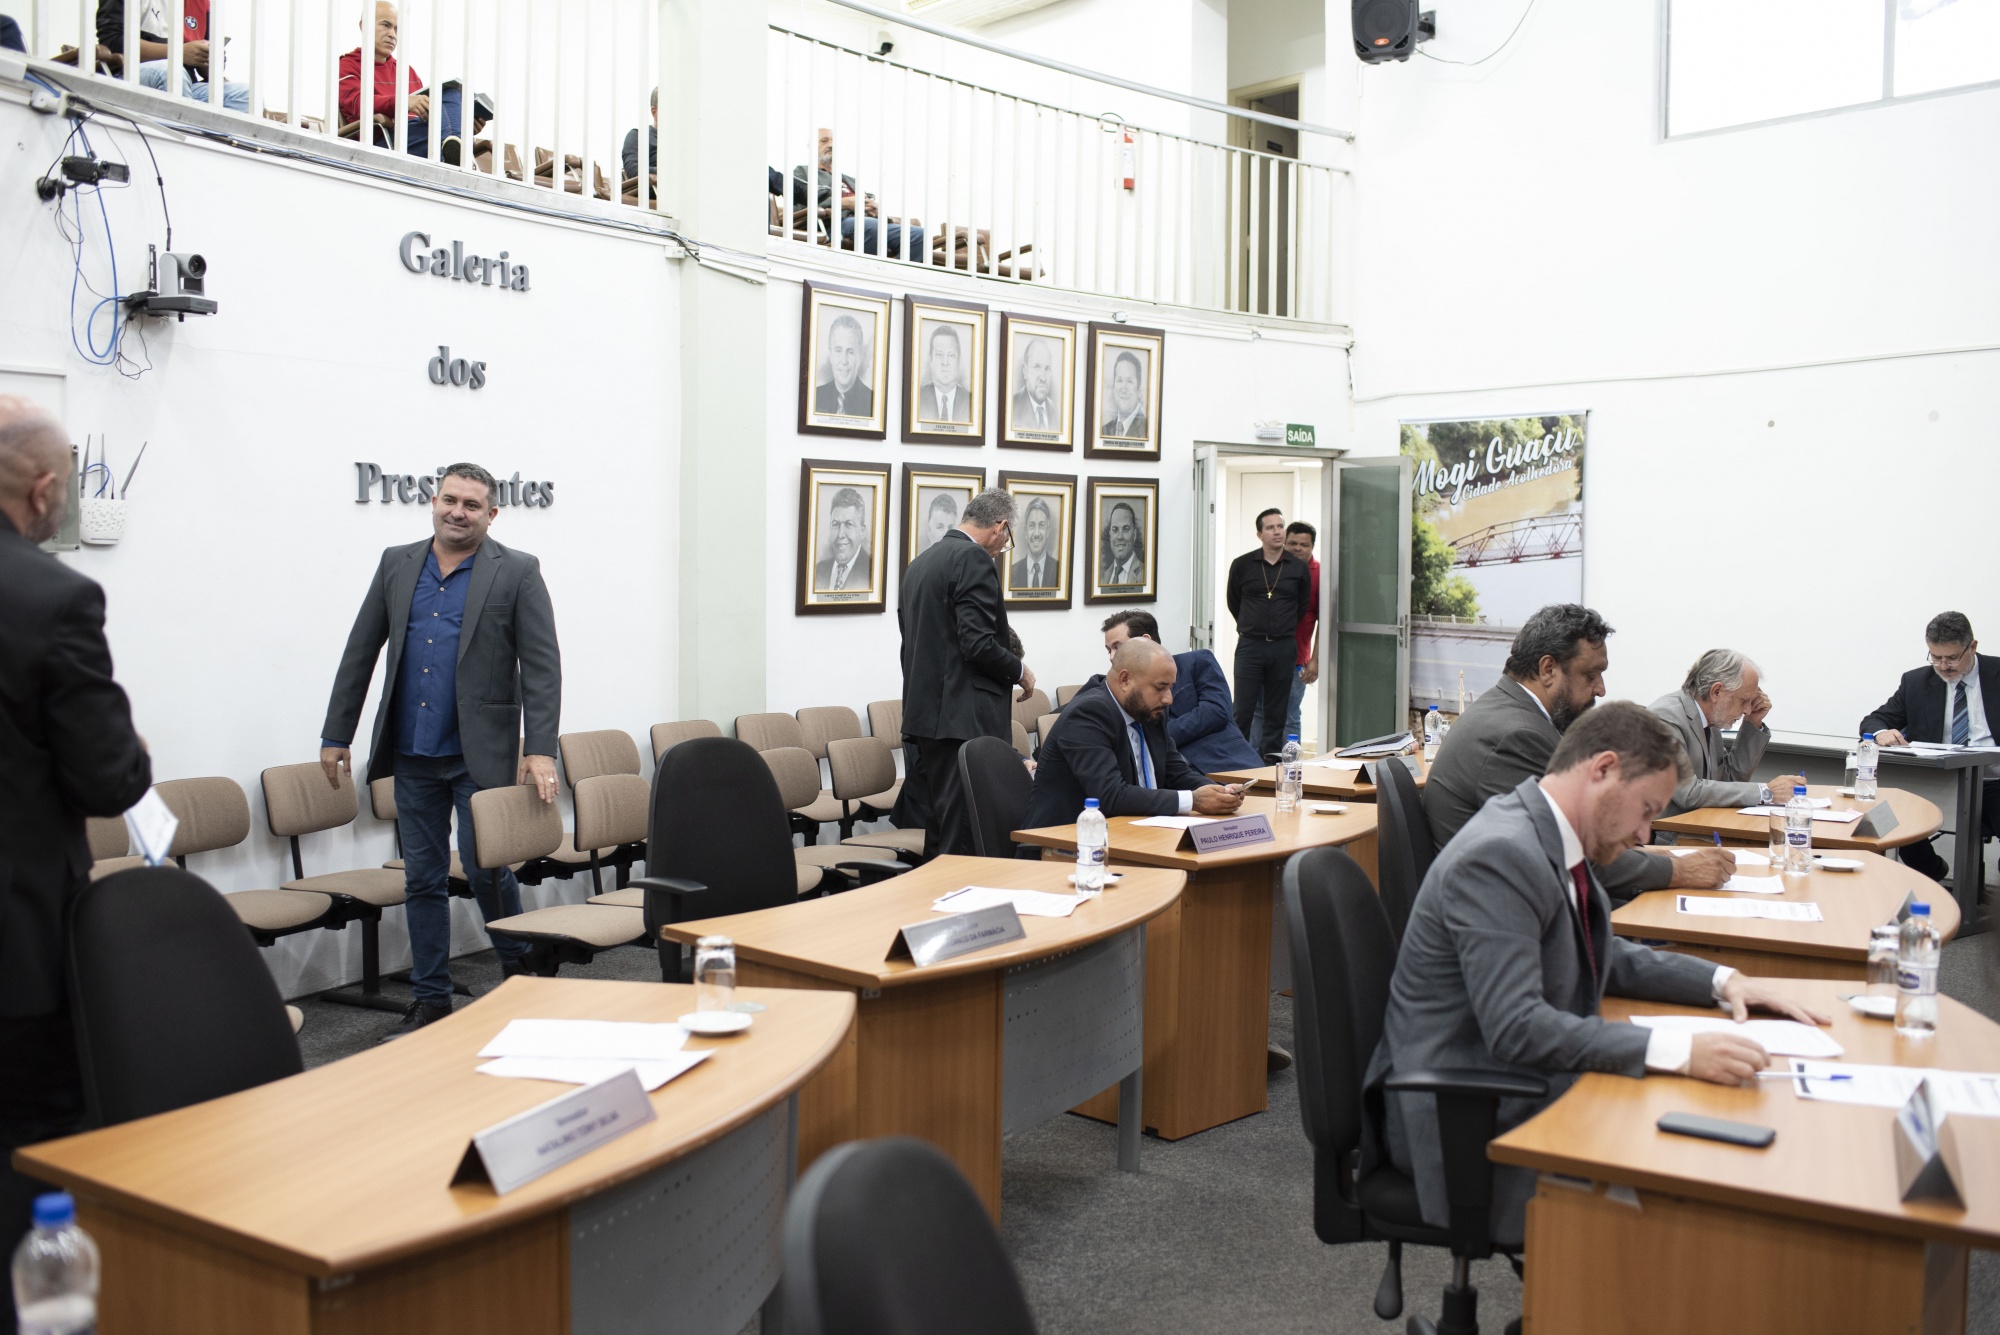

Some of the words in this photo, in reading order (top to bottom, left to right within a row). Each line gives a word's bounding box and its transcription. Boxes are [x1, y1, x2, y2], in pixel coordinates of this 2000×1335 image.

[399, 231, 531, 292] Galeria
[428, 345, 486, 389] dos
[1288, 428, 1313, 442] SAÍDA
[355, 462, 554, 507] Presintes
[1413, 449, 1479, 504] Mogi
[1486, 427, 1577, 474] Guaçu
[1462, 478, 1501, 501] Cidade
[1504, 458, 1573, 488] Acolhedora
[1200, 835, 1218, 844] PAULO
[1219, 831, 1244, 842] HENRIQUE
[1244, 827, 1266, 837] PEREIRA
